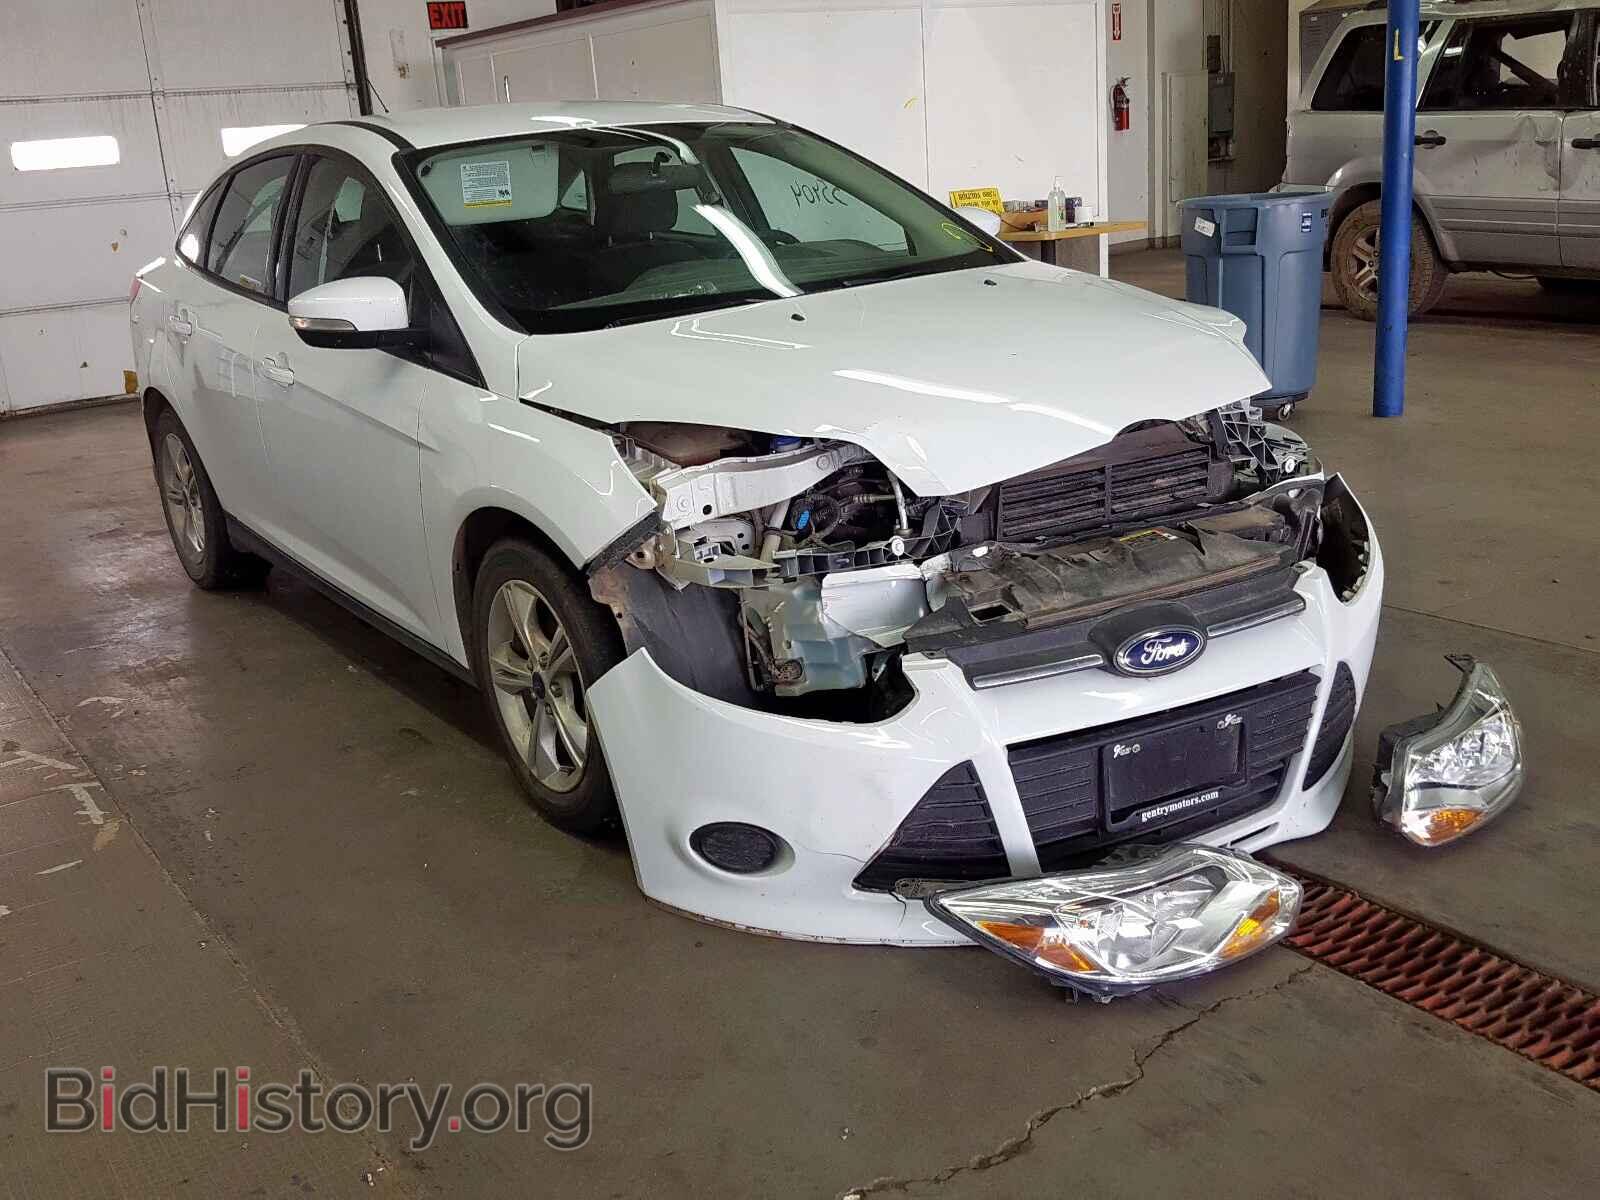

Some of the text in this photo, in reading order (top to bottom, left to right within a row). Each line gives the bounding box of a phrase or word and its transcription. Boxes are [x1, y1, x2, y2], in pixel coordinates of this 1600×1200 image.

[429, 3, 466, 28] EXIT
[1141, 636, 1190, 664] Ford
[1141, 790, 1219, 822] gentrymotors.com
